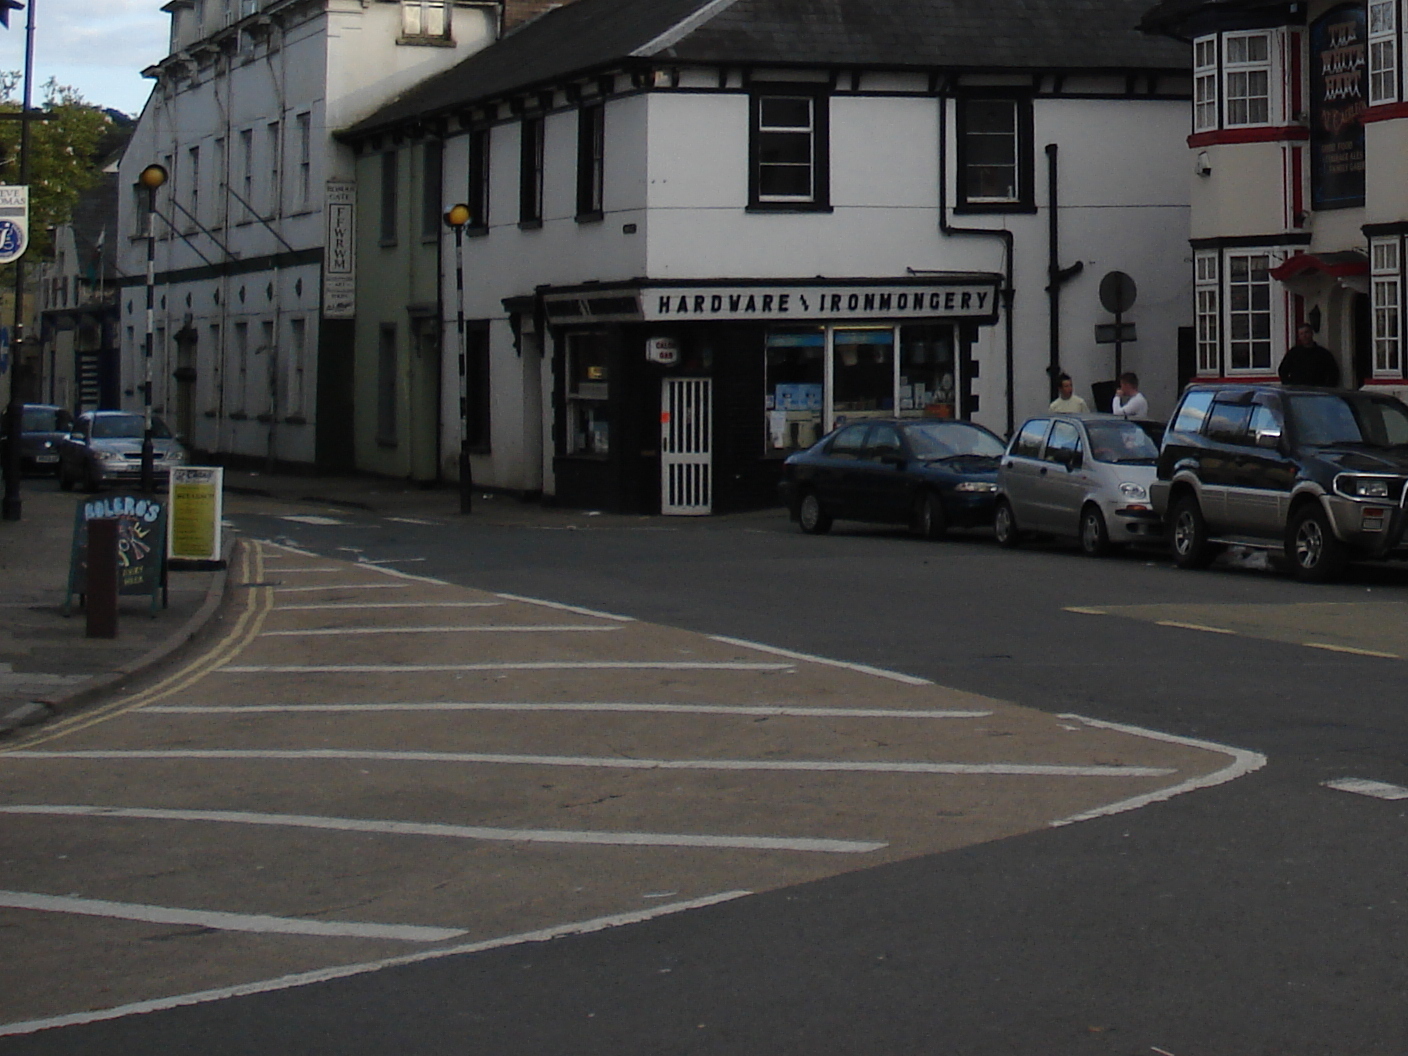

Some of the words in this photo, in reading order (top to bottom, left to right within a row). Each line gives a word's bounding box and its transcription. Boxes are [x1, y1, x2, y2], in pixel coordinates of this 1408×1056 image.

[1328, 21, 1357, 50] THE
[1320, 43, 1366, 76] WHITE
[1324, 70, 1362, 103] HART
[659, 293, 790, 314] HARDWARE
[819, 291, 989, 313] IRONMONGERY
